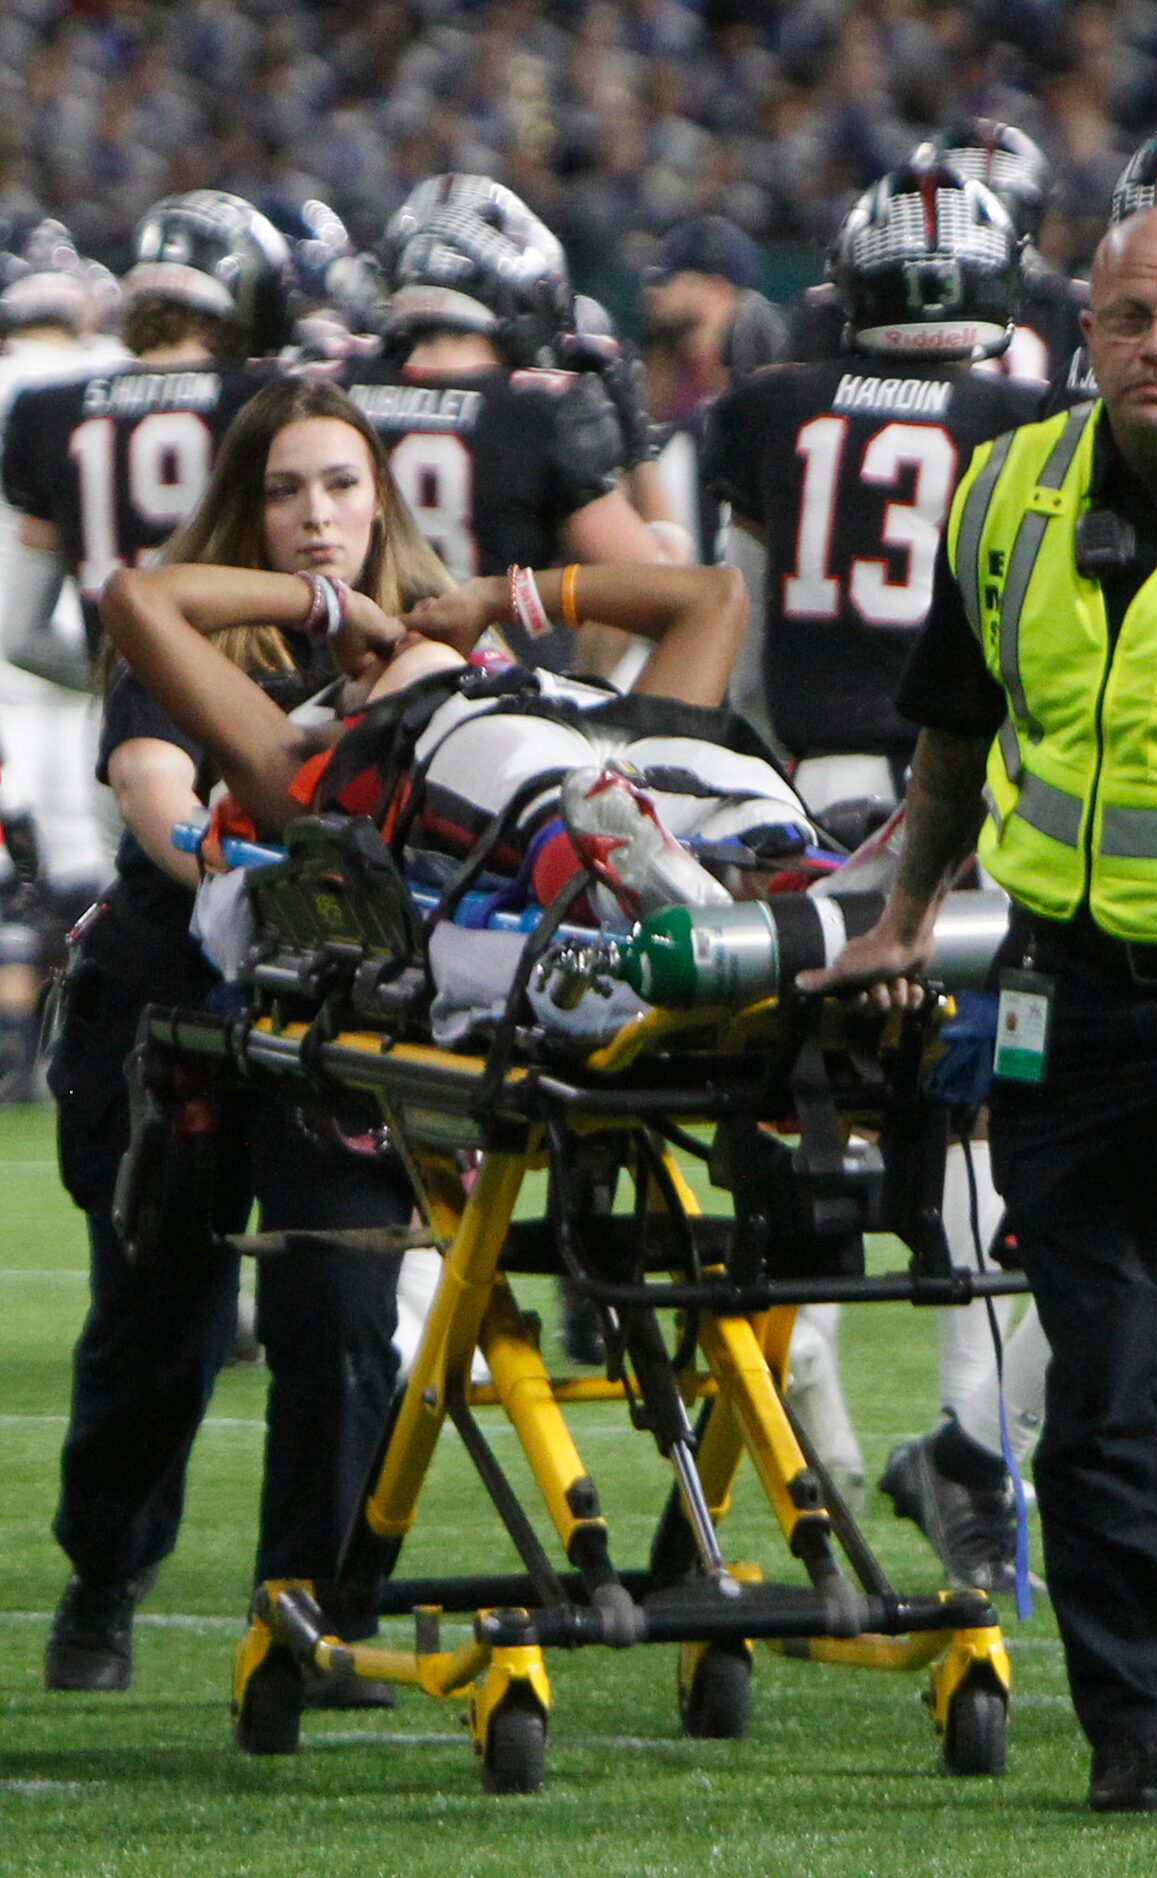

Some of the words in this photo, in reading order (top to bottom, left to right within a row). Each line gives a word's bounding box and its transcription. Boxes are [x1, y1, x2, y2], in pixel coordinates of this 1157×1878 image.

[831, 374, 953, 413] HARDIN
[67, 410, 214, 601] 19
[784, 413, 959, 627] 13
